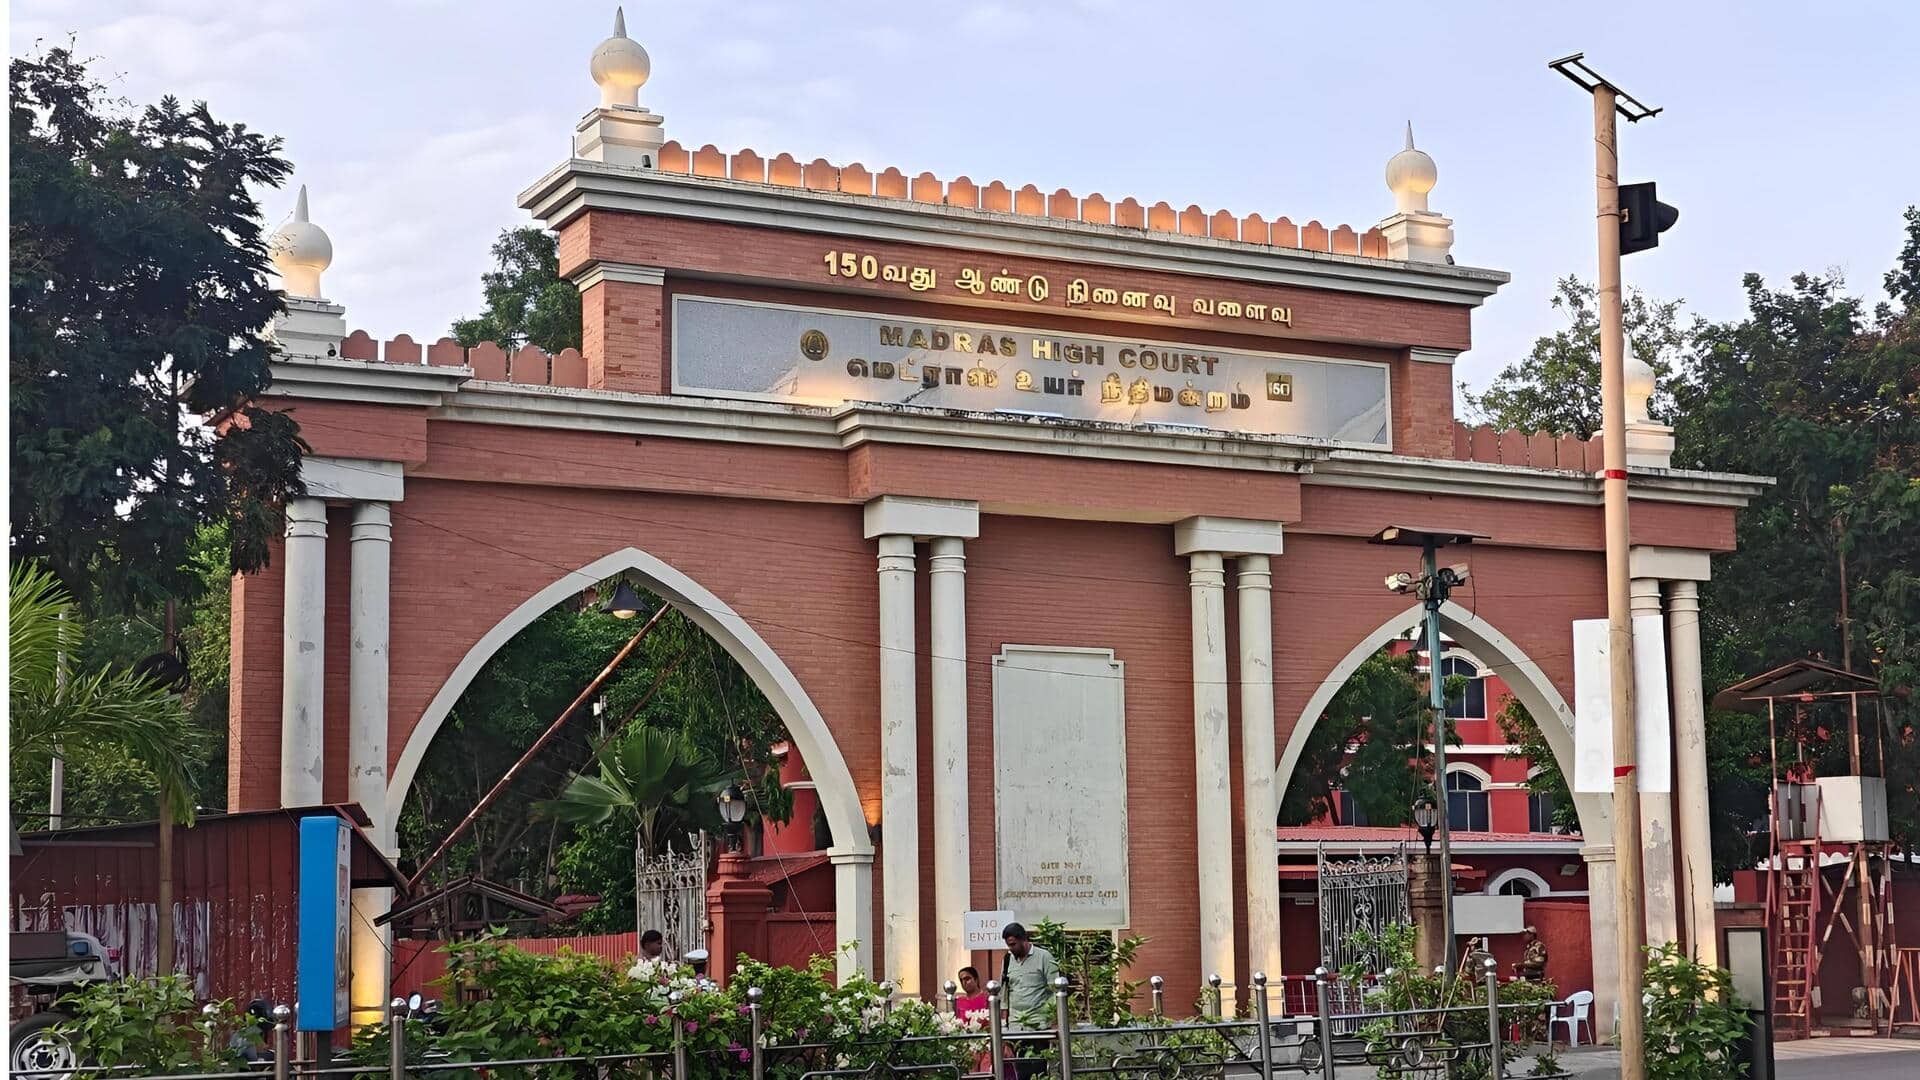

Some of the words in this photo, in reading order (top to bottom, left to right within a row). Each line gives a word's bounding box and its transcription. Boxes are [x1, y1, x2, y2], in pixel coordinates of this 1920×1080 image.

[824, 250, 937, 291] 150வது
[954, 267, 1049, 302] ஆண்டு
[1065, 278, 1175, 316] நினைவு
[1192, 298, 1292, 327] வளைவு
[879, 325, 1017, 357] MADRAS
[1032, 338, 1105, 366] HIGH
[1118, 347, 1220, 376] COURT
[846, 357, 1000, 389] மெட்ராஸ்
[1015, 369, 1085, 397] உயர்
[1101, 371, 1251, 413] நீதிமன்றம்
[1031, 875, 1062, 885] SOUTH
[1067, 875, 1092, 885] GATE
[1040, 861, 1060, 870] GATE
[980, 919, 998, 929] NO
